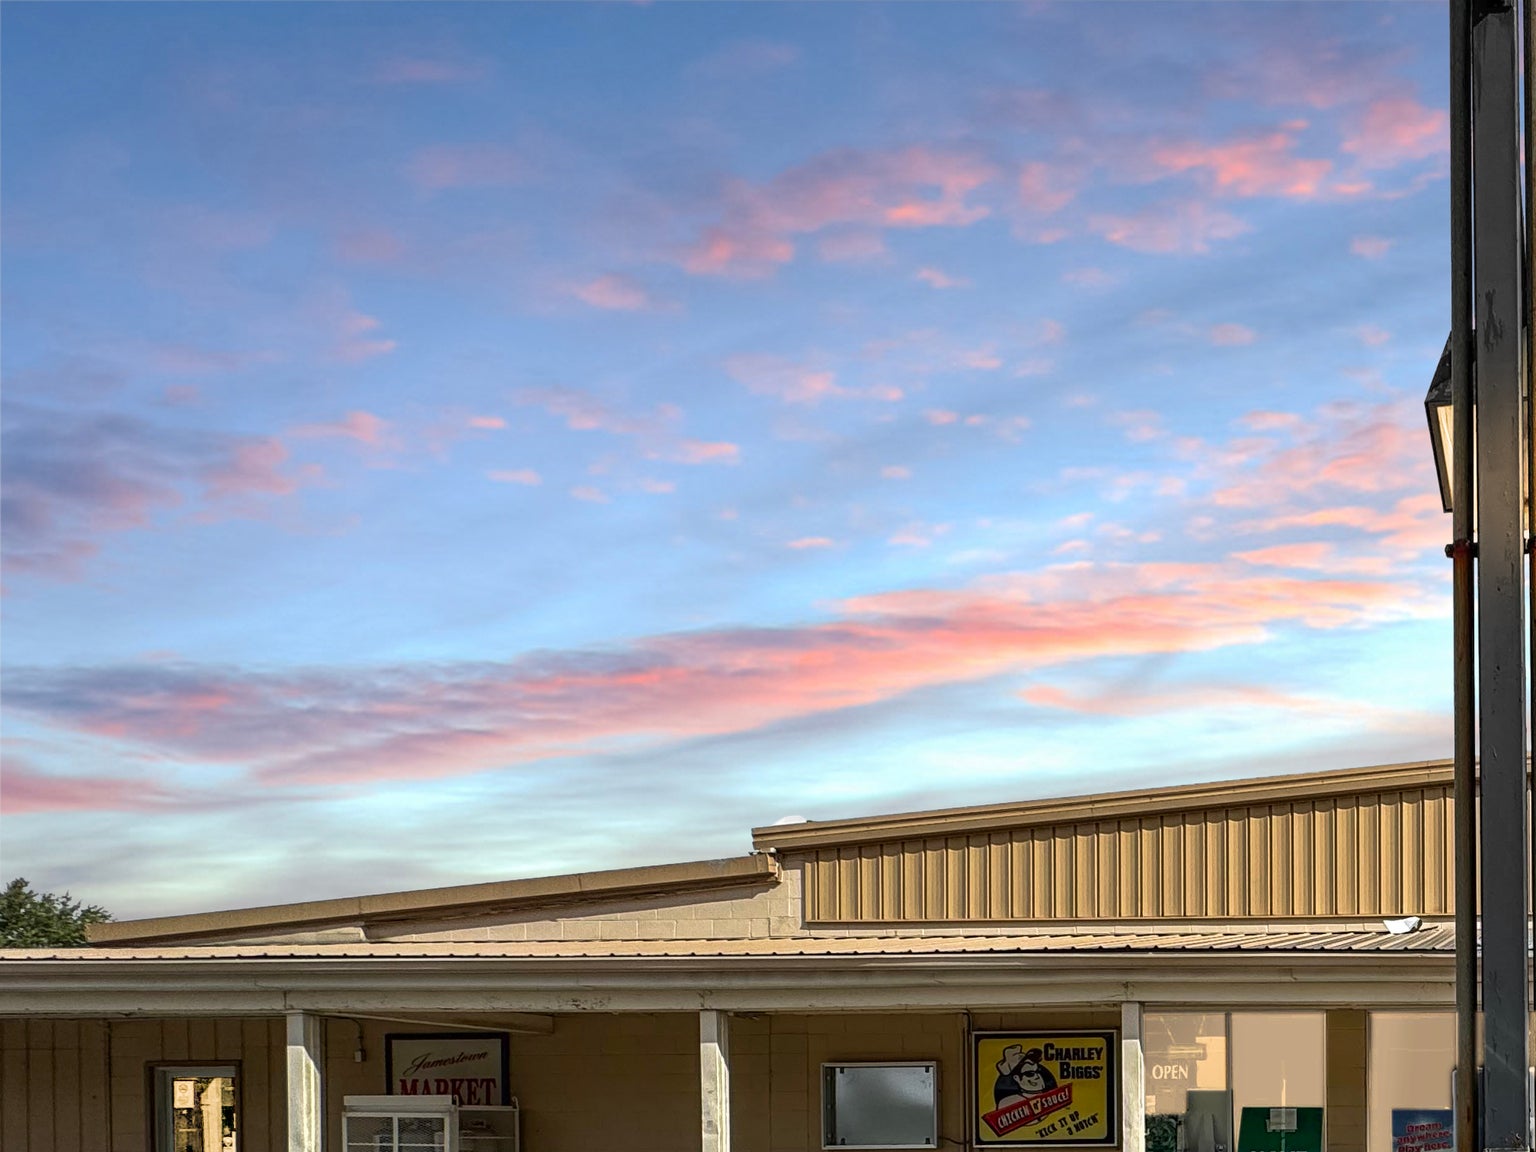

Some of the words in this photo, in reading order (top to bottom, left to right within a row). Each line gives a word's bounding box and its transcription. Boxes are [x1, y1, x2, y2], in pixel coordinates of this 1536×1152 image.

[403, 1052, 488, 1076] Jamestown
[1152, 1064, 1189, 1080] OPEN
[1058, 1117, 1068, 1129] IT
[1070, 1111, 1080, 1123] UP
